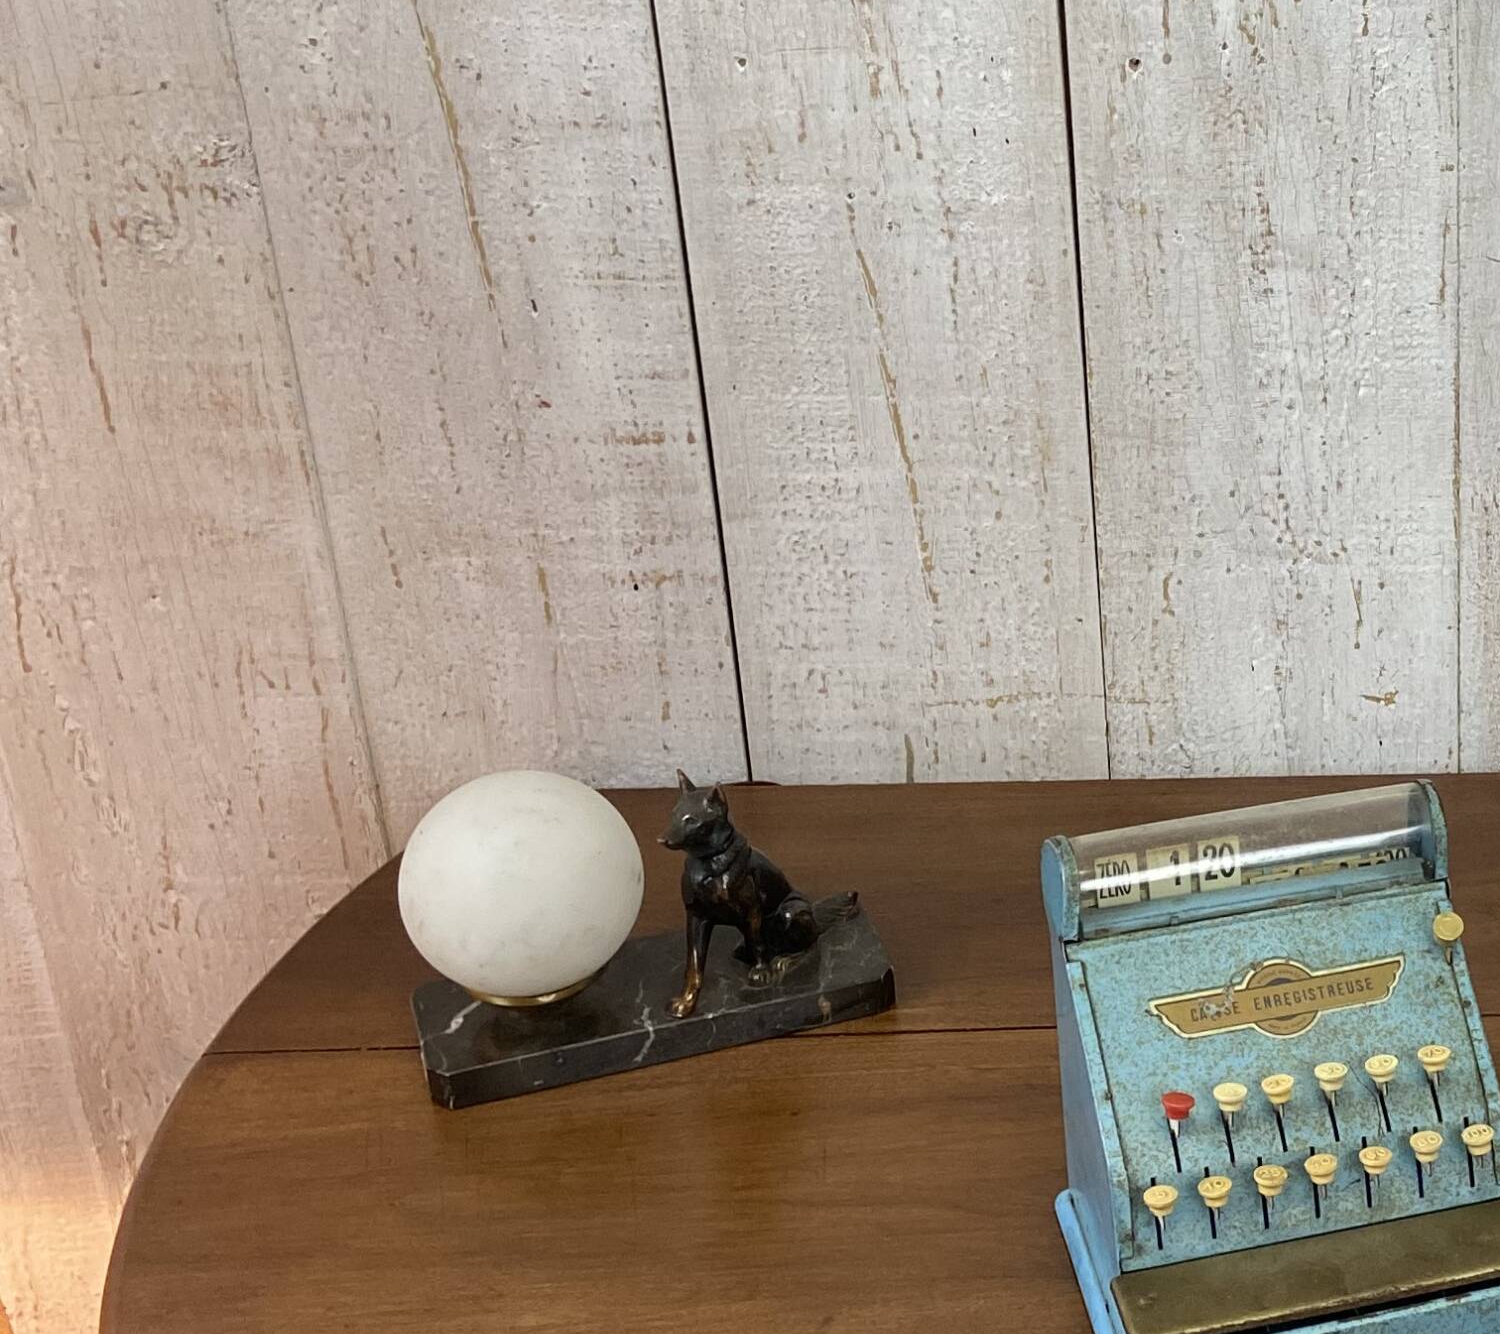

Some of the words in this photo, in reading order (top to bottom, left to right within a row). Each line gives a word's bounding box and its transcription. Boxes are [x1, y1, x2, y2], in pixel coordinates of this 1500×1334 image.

[1168, 850, 1183, 887] 1
[1202, 842, 1236, 881] 20
[1254, 976, 1375, 1011] ENREGISTREUSE
